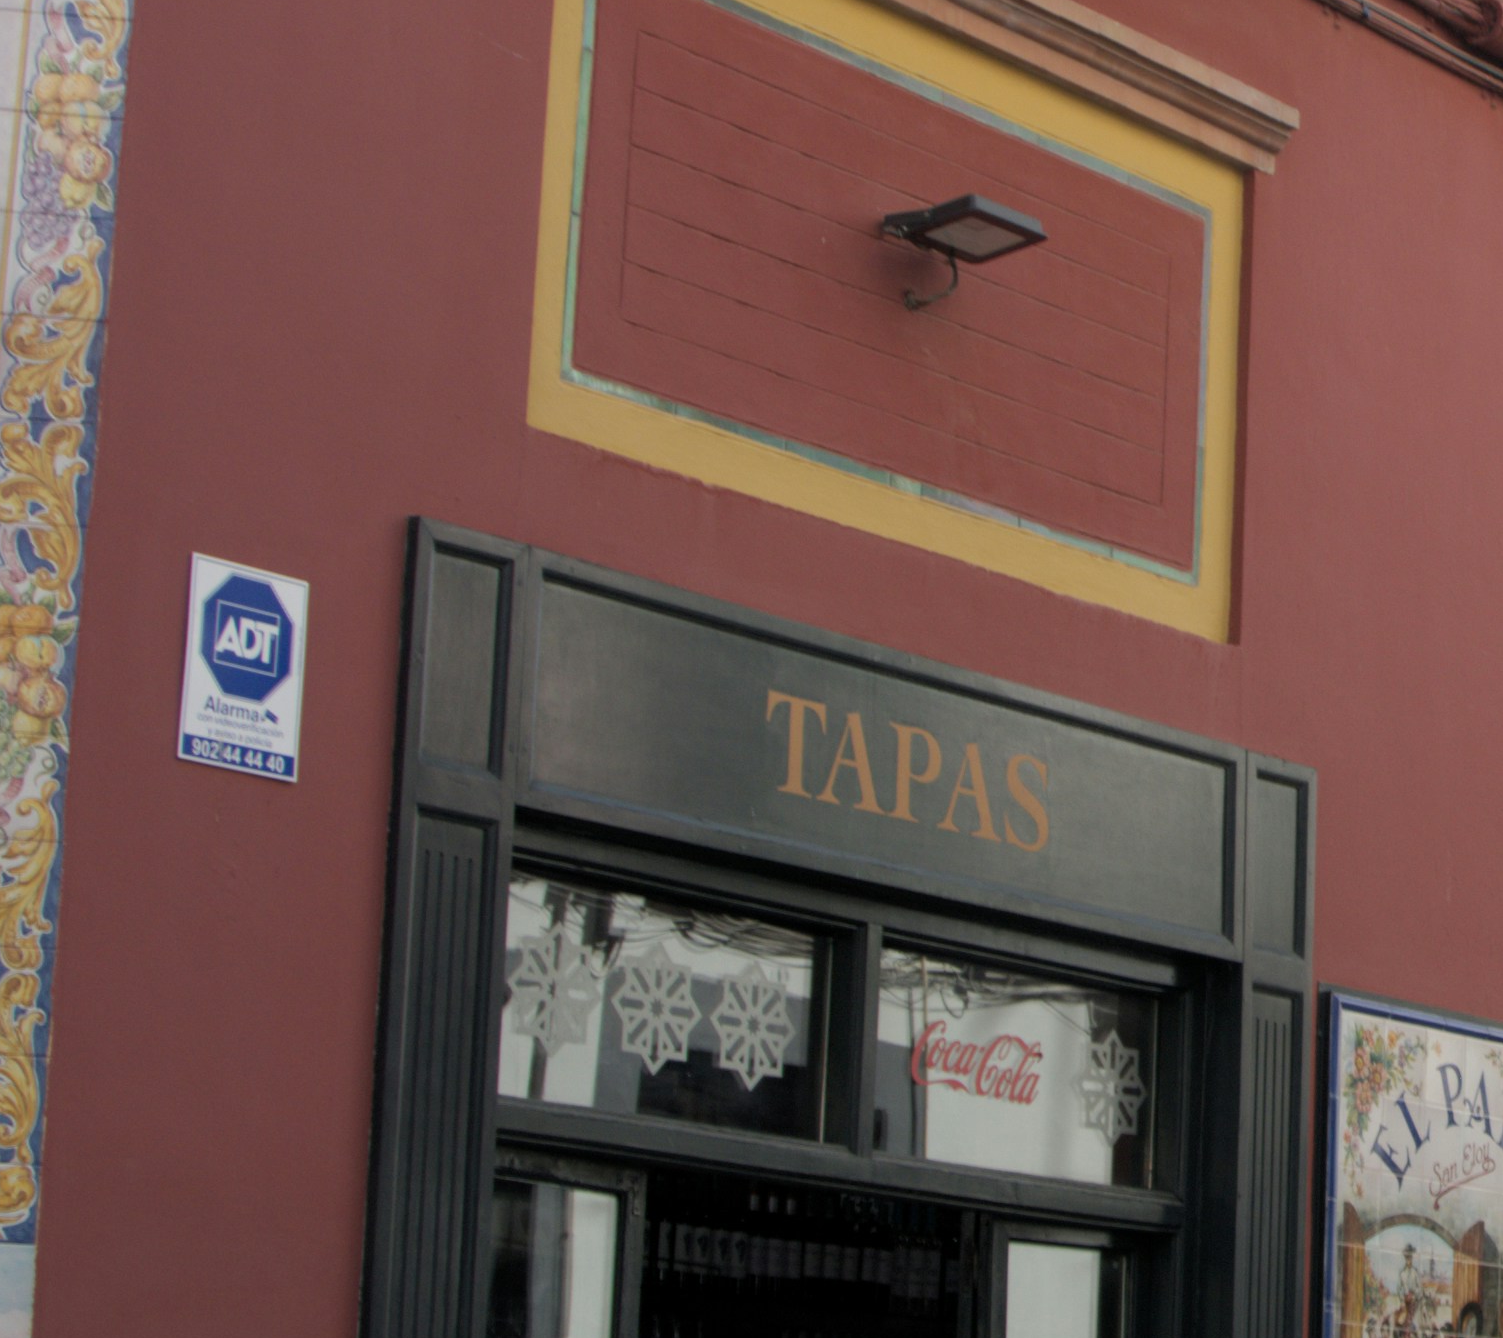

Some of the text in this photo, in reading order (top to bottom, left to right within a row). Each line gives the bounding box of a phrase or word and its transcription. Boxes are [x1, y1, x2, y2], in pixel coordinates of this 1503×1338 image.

[215, 615, 280, 664] ADT
[204, 695, 260, 723] Alarma
[191, 737, 285, 774] 902 44 44 40
[765, 688, 1051, 853] TAPAS
[910, 1019, 1043, 1107] Coca-Cola
[1370, 1090, 1432, 1193] EL
[1428, 1140, 1495, 1199] San Eloy
